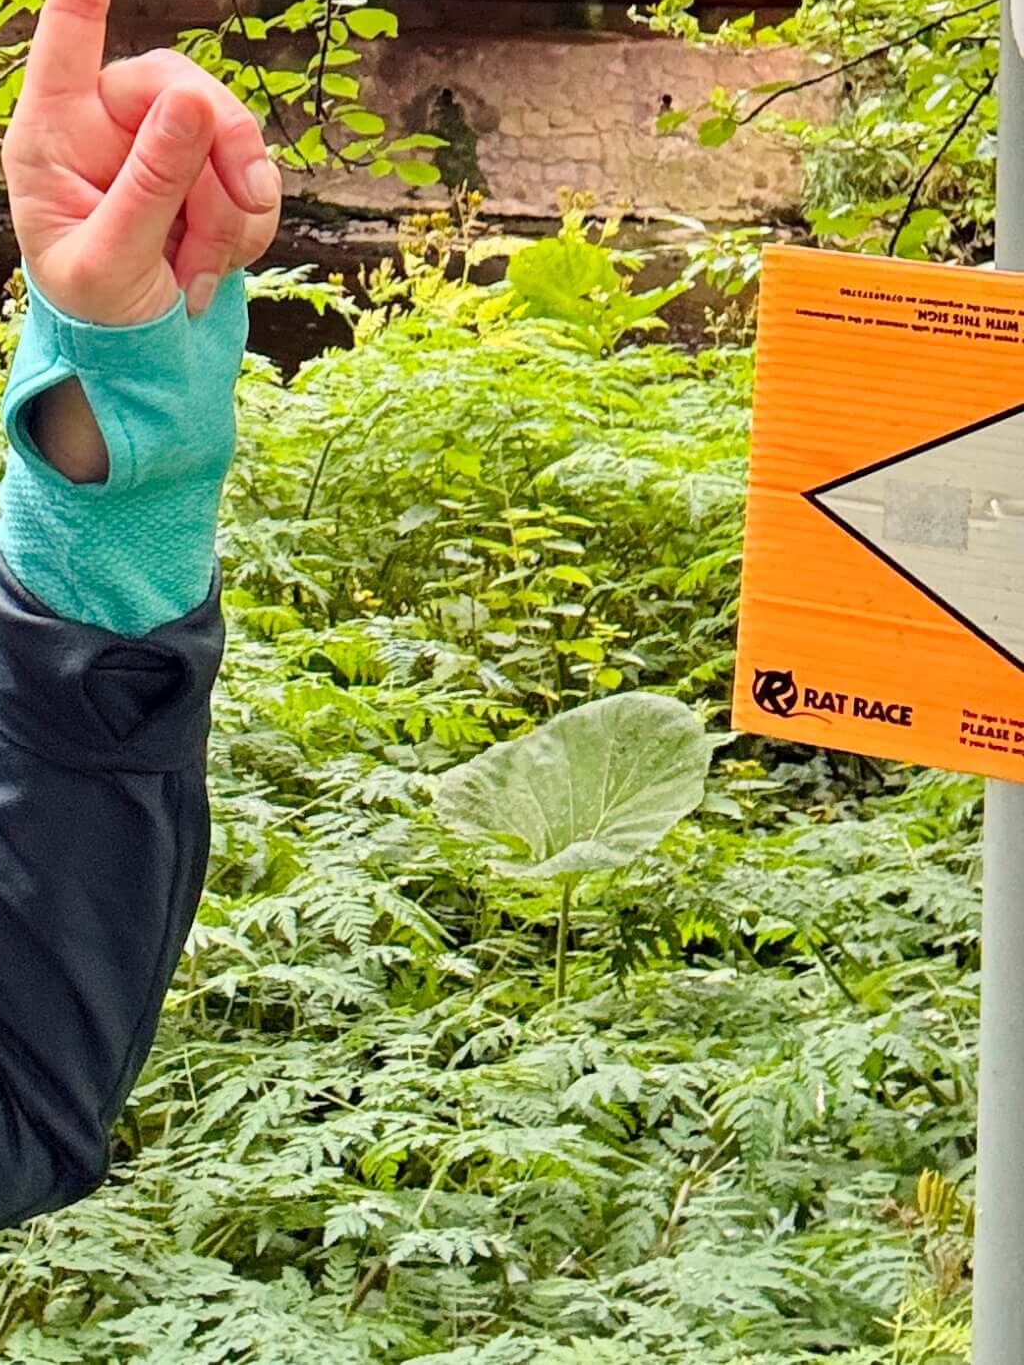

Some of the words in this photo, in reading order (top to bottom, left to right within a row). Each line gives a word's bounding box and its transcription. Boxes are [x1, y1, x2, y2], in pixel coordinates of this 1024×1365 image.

[966, 303, 980, 312] the
[983, 306, 1015, 315] contact
[914, 309, 948, 324] SIGN.
[952, 313, 980, 327] THIS
[986, 317, 1019, 332] WITH
[933, 327, 963, 337] placed
[803, 687, 849, 715] RAT
[852, 696, 914, 727] RACE
[961, 721, 1010, 740] PLEASE
[1014, 731, 1024, 743] D
